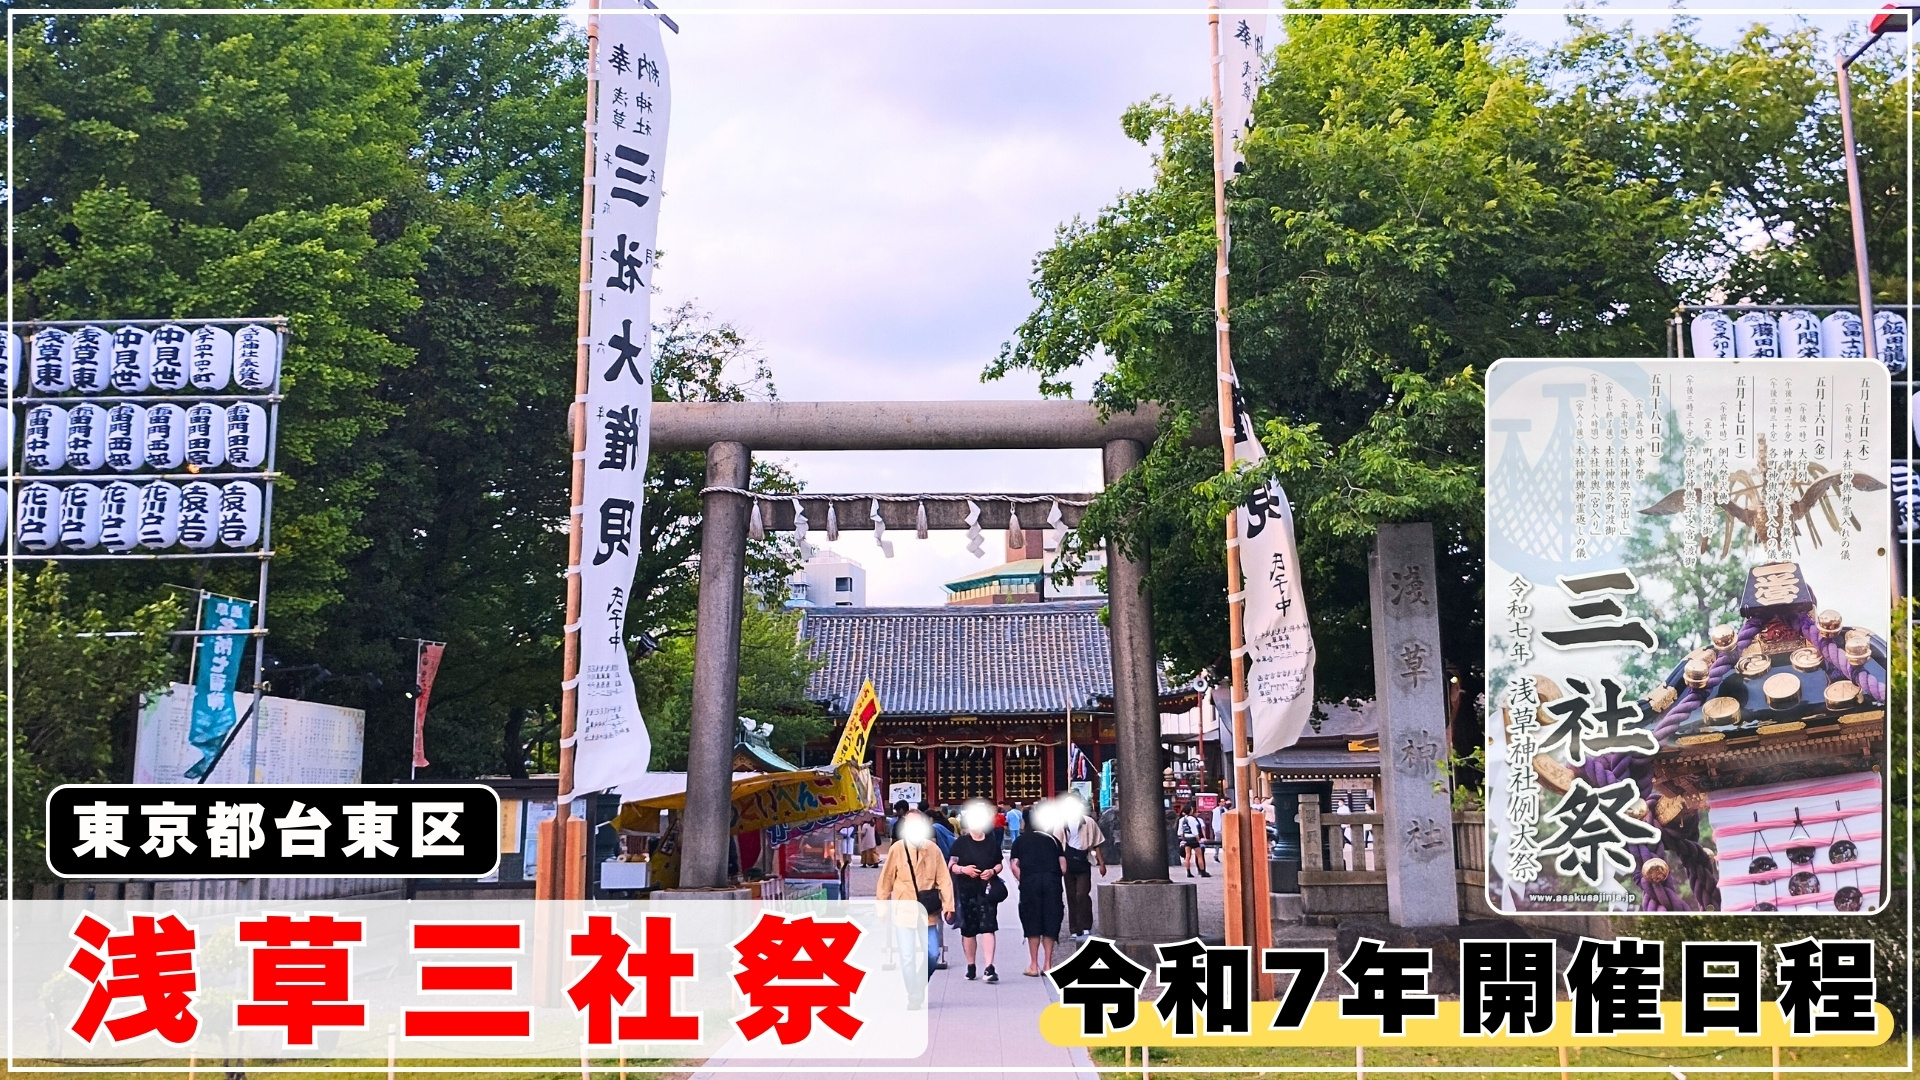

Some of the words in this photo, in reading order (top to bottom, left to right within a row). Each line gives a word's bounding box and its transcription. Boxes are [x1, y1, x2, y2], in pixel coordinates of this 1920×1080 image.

[1635, 445, 1645, 480] 神幸祭
[1717, 447, 1729, 504] 例大祭式典
[1797, 448, 1808, 482] 大行列
[19, 487, 48, 546] 花川戸一
[60, 487, 89, 545] 花川戸一
[100, 485, 128, 545] 花川戸二
[139, 485, 170, 543] 花川戸二
[1508, 576, 1530, 663] 令和七年
[1540, 571, 1657, 882] 三社祭
[1507, 677, 1539, 881] 浅草神社例大祭
[1529, 892, 1636, 904] www.asakusajinja.jp
